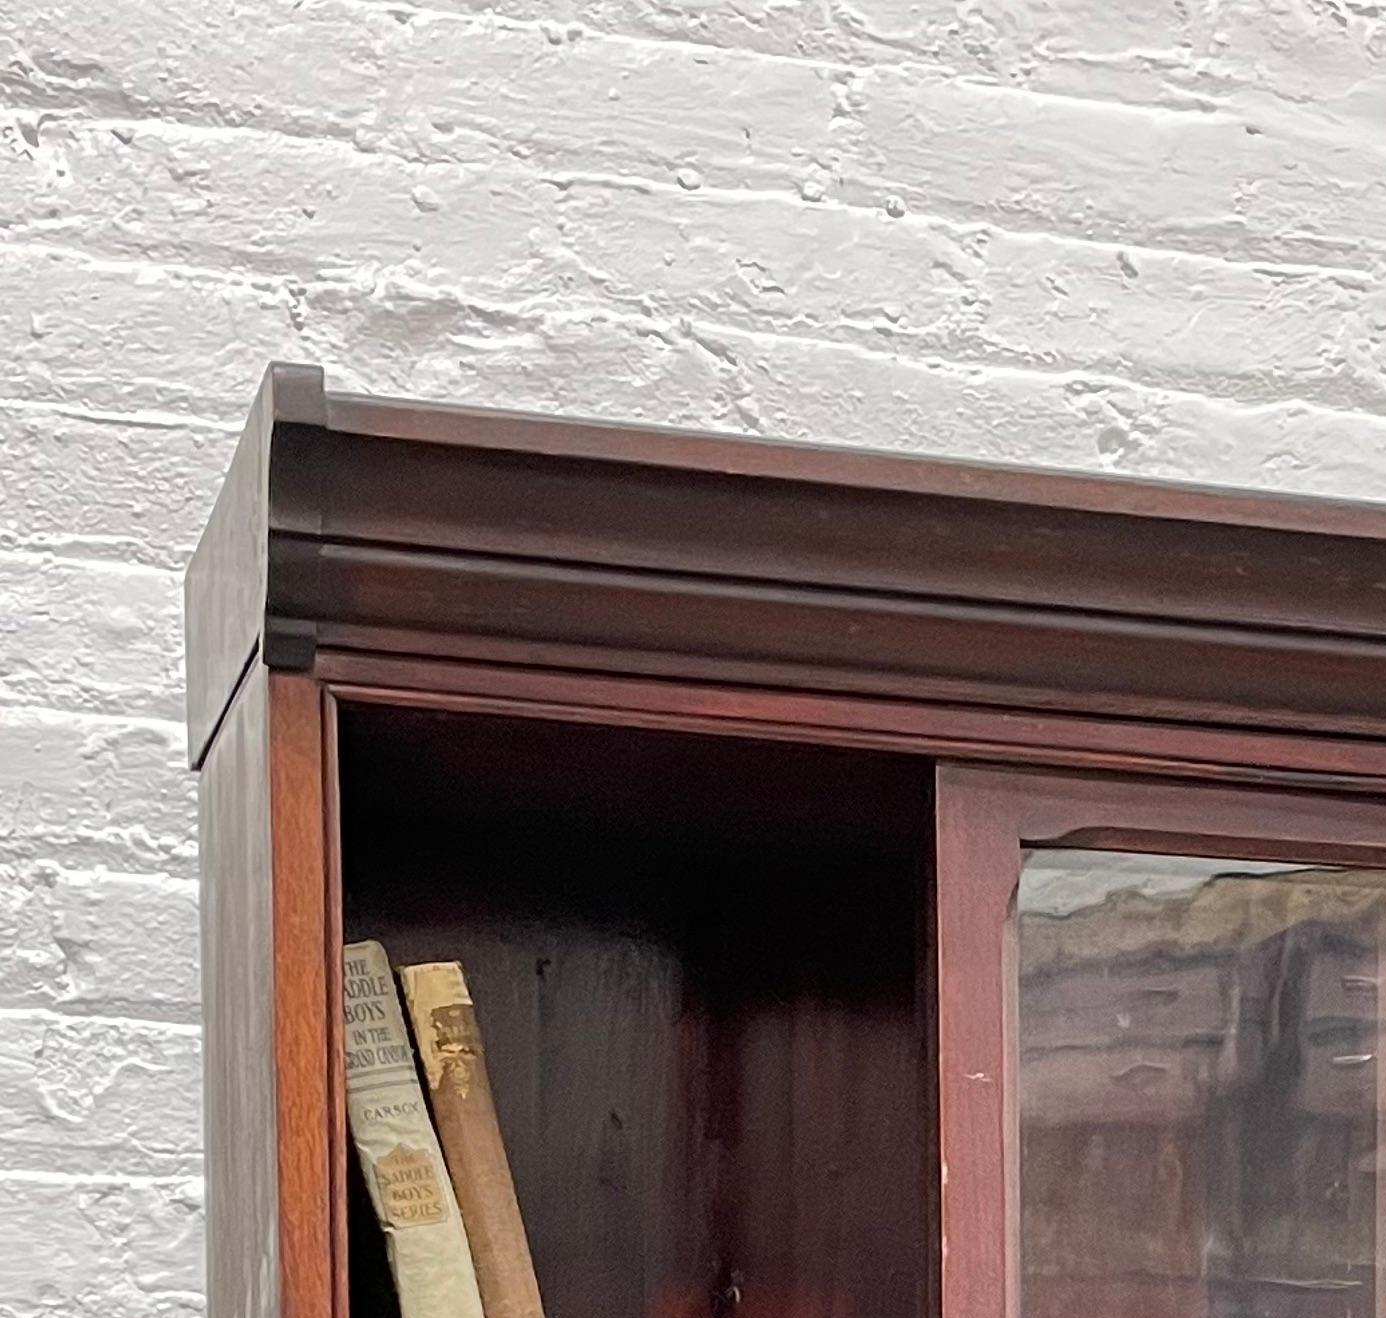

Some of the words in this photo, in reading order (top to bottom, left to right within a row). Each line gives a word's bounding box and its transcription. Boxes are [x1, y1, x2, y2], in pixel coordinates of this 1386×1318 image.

[343, 977, 389, 998] ADDLE
[343, 1001, 386, 1025] BOYS
[352, 1030, 368, 1046] IN
[368, 1026, 391, 1044] THE
[363, 1101, 418, 1121] CARSON
[380, 1165, 433, 1186] SADDLE
[392, 1184, 433, 1201] BOYS
